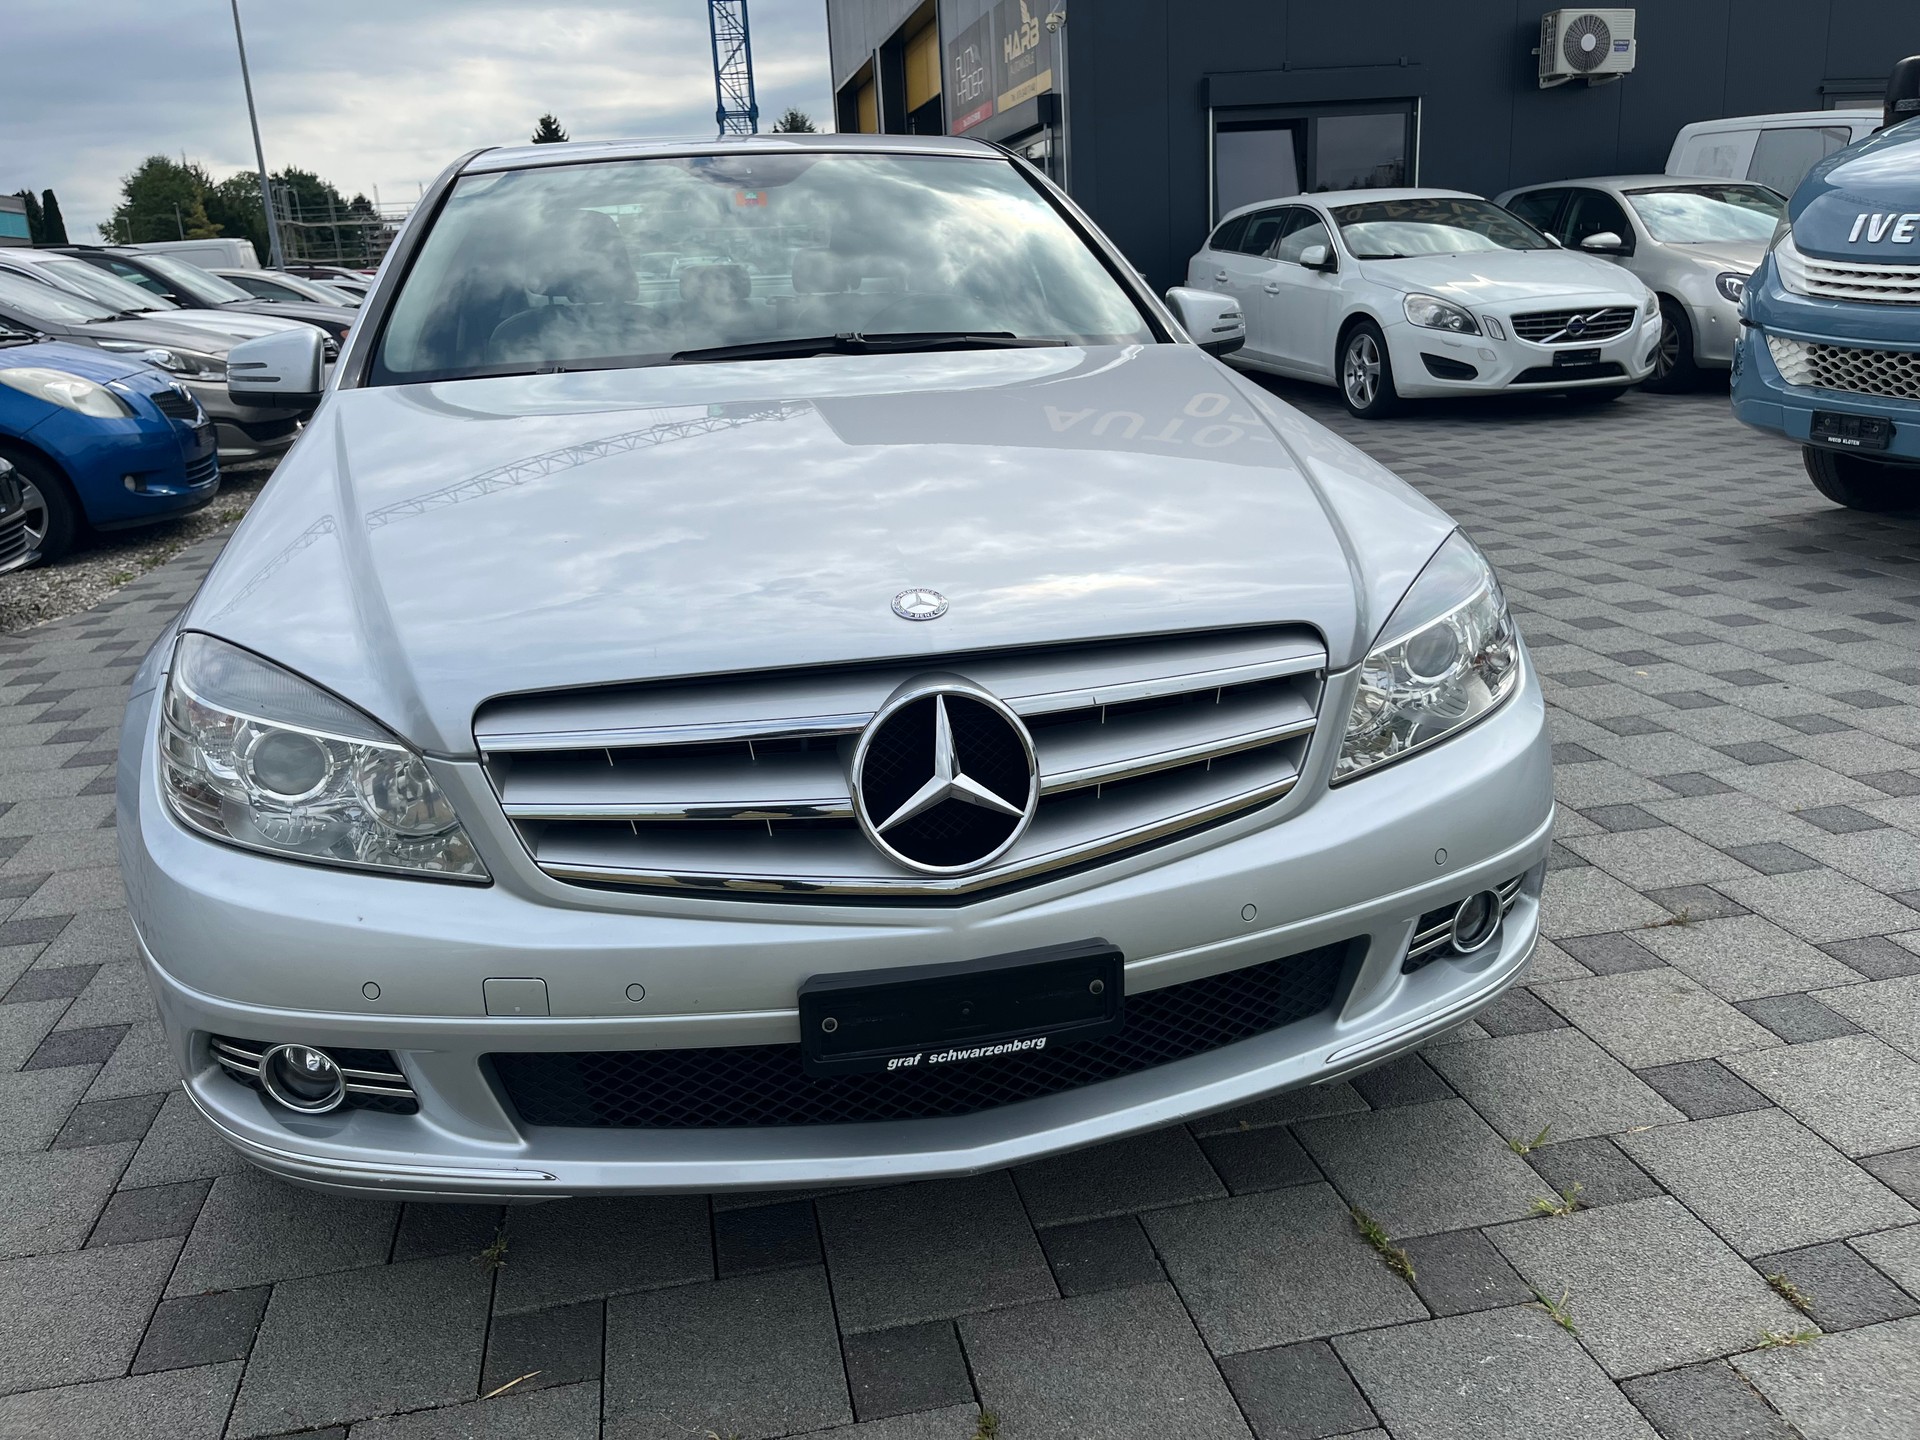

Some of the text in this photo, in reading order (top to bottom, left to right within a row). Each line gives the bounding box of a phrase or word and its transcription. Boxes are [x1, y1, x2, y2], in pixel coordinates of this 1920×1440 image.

[1004, 17, 1040, 64] HARB
[1848, 213, 1920, 243] IVE
[887, 1037, 1047, 1071] graf schwarzenberg
